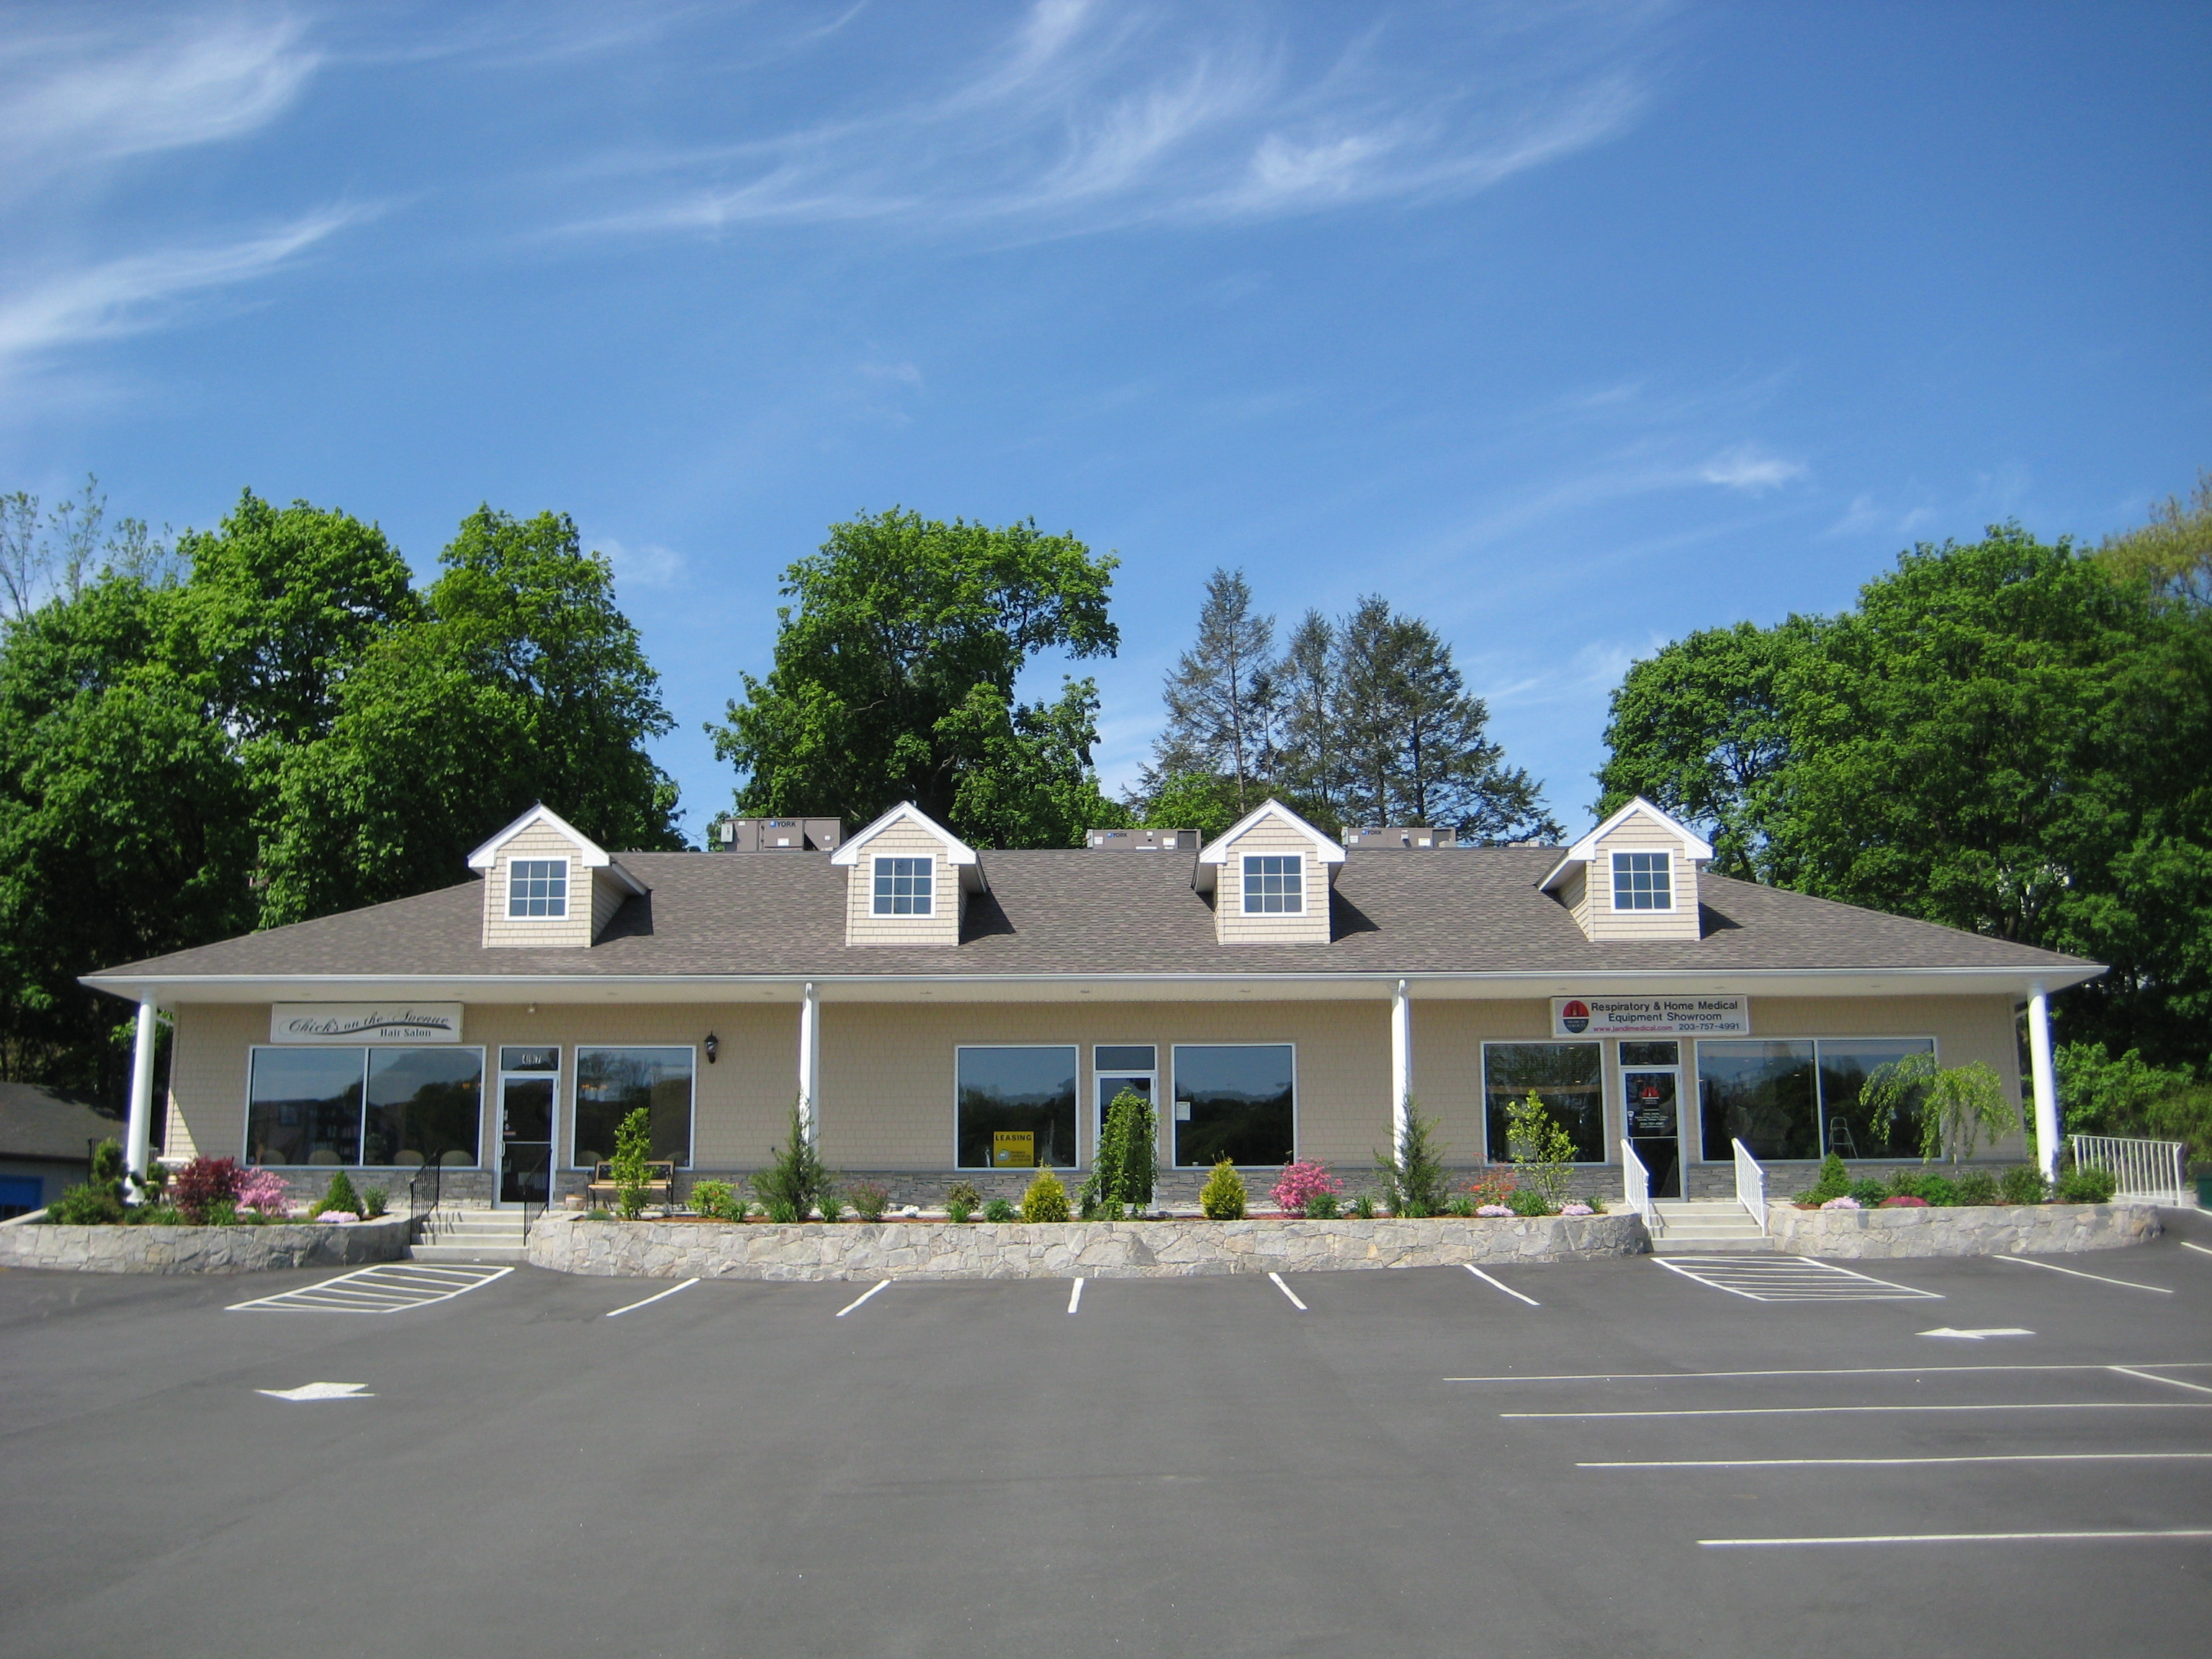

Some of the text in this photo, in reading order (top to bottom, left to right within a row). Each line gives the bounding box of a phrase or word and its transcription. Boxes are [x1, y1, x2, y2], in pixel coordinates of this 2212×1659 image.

[1591, 1002, 1650, 1012] Respiratory
[1664, 1002, 1694, 1010] Home
[1698, 1001, 1737, 1010] Medical
[279, 1008, 449, 1035] Chick's on the Avenue
[1608, 1012, 1722, 1023] Equipment Showroom
[380, 1028, 431, 1038] Hair Salon
[522, 1054, 541, 1064] 497
